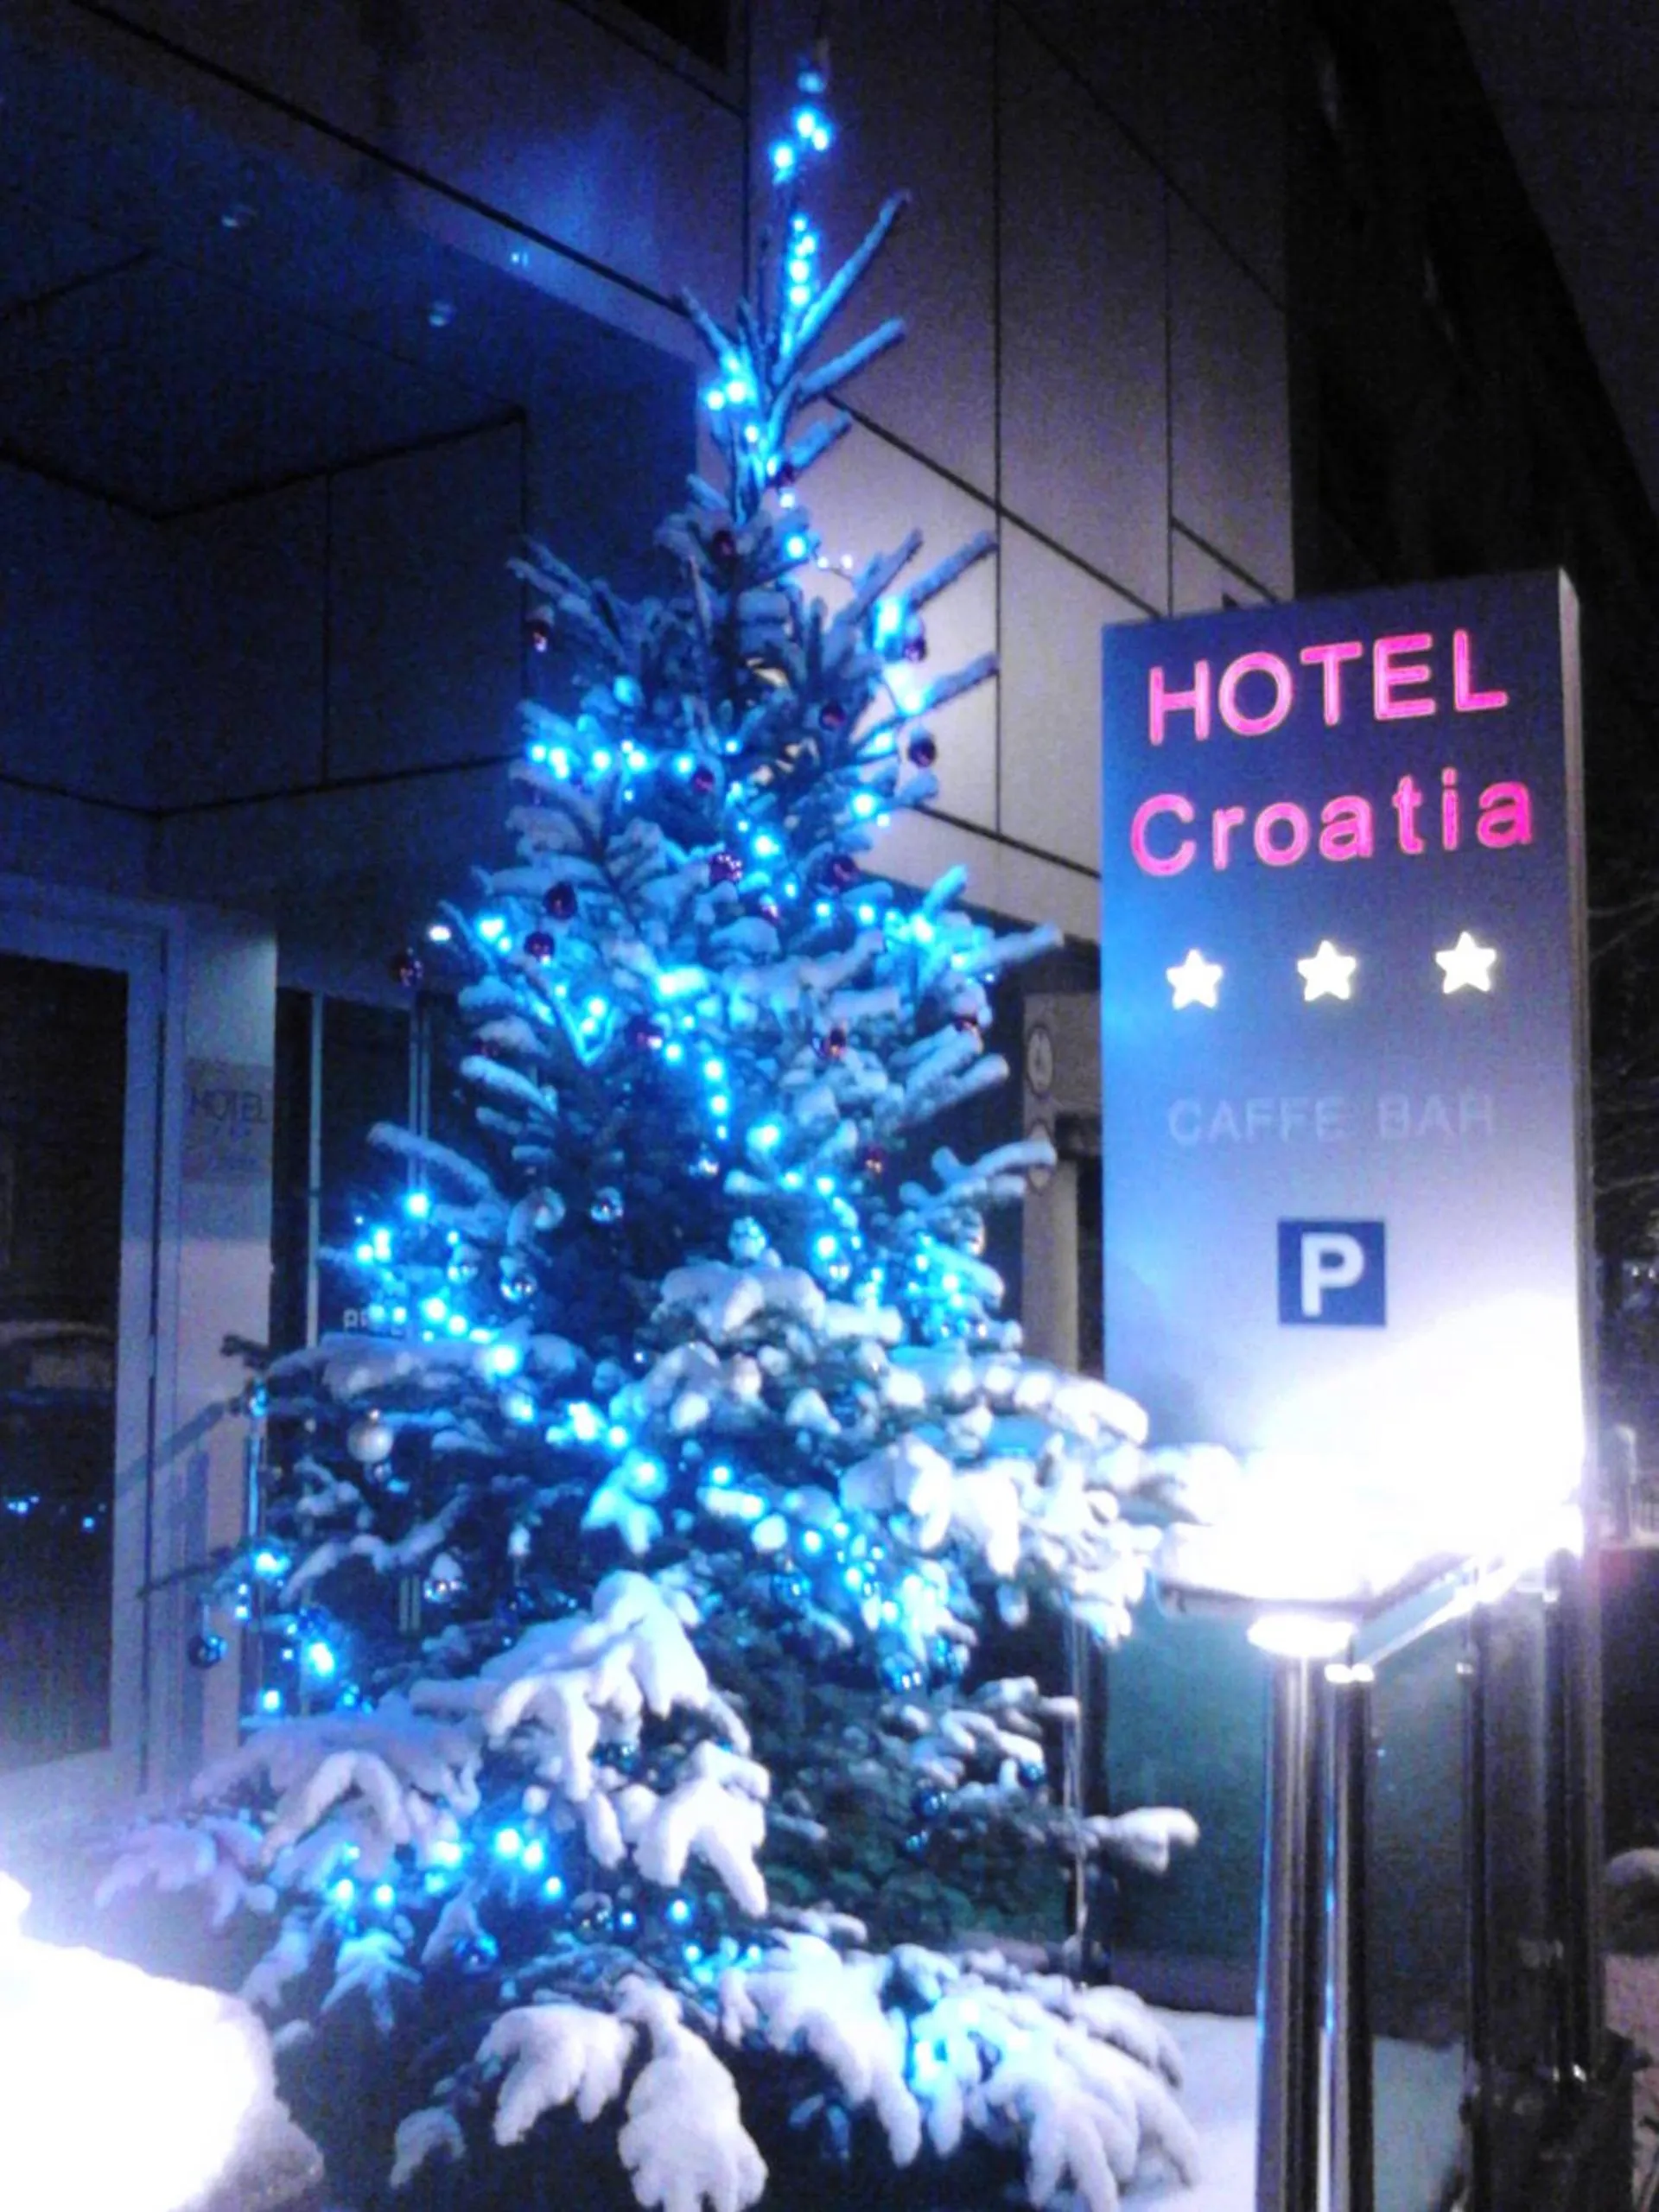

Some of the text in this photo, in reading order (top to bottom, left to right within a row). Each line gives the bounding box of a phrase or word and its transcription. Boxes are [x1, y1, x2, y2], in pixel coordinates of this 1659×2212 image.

[1147, 628, 1509, 746] HOTEL
[1129, 766, 1533, 877] Croatia
[1166, 1095, 1345, 1147] CAFFE
[1300, 1230, 1366, 1318] P
